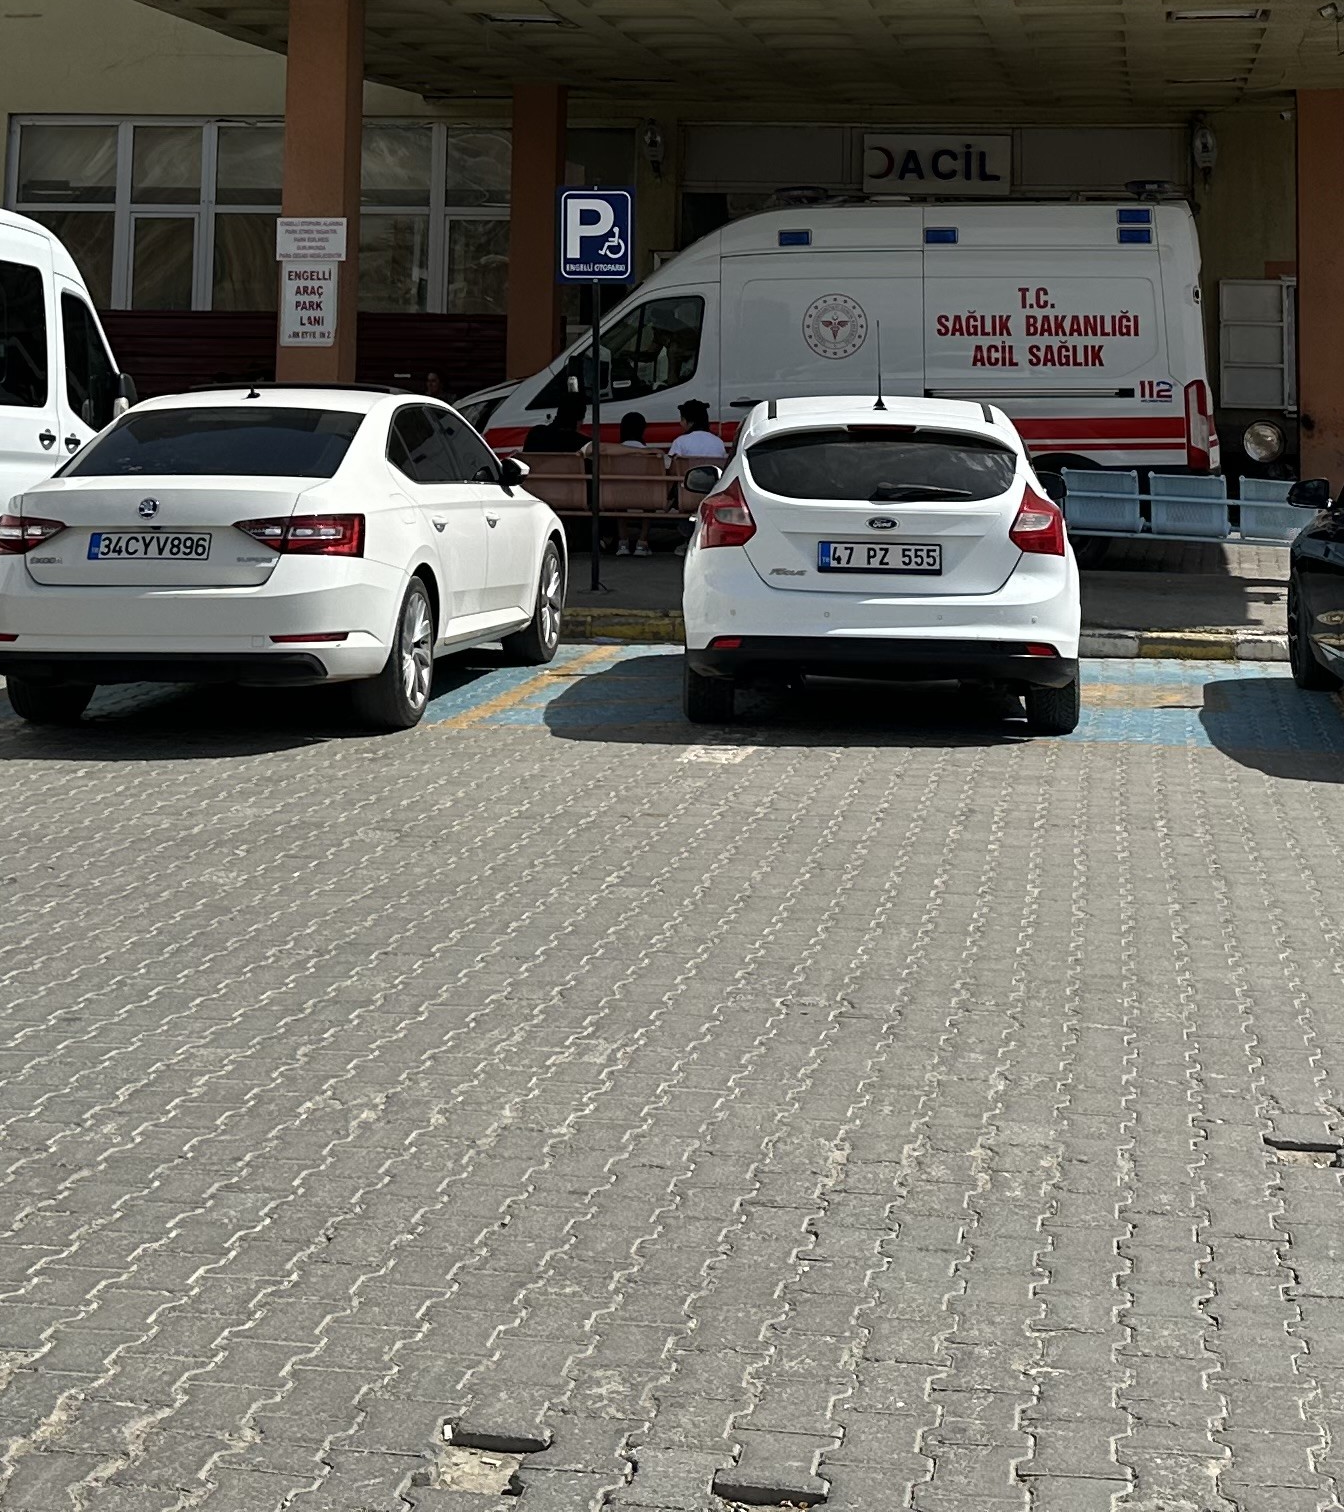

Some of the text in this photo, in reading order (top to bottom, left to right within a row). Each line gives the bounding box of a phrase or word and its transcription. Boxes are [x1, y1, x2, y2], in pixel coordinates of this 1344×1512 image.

[898, 144, 1001, 181] ACİL
[567, 199, 614, 258] P
[288, 268, 331, 281] ENGELLİ
[295, 285, 323, 299] ARAÇ
[1018, 287, 1055, 309] T.C.
[295, 301, 323, 311] PARK
[937, 310, 1140, 337] SAĞLIK BAKANLIĞI
[972, 340, 1104, 367] ACİL SAĞLIK
[1139, 380, 1173, 399] 112
[832, 546, 854, 564] 47
[866, 548, 889, 566] PZ
[901, 549, 937, 567] 555
